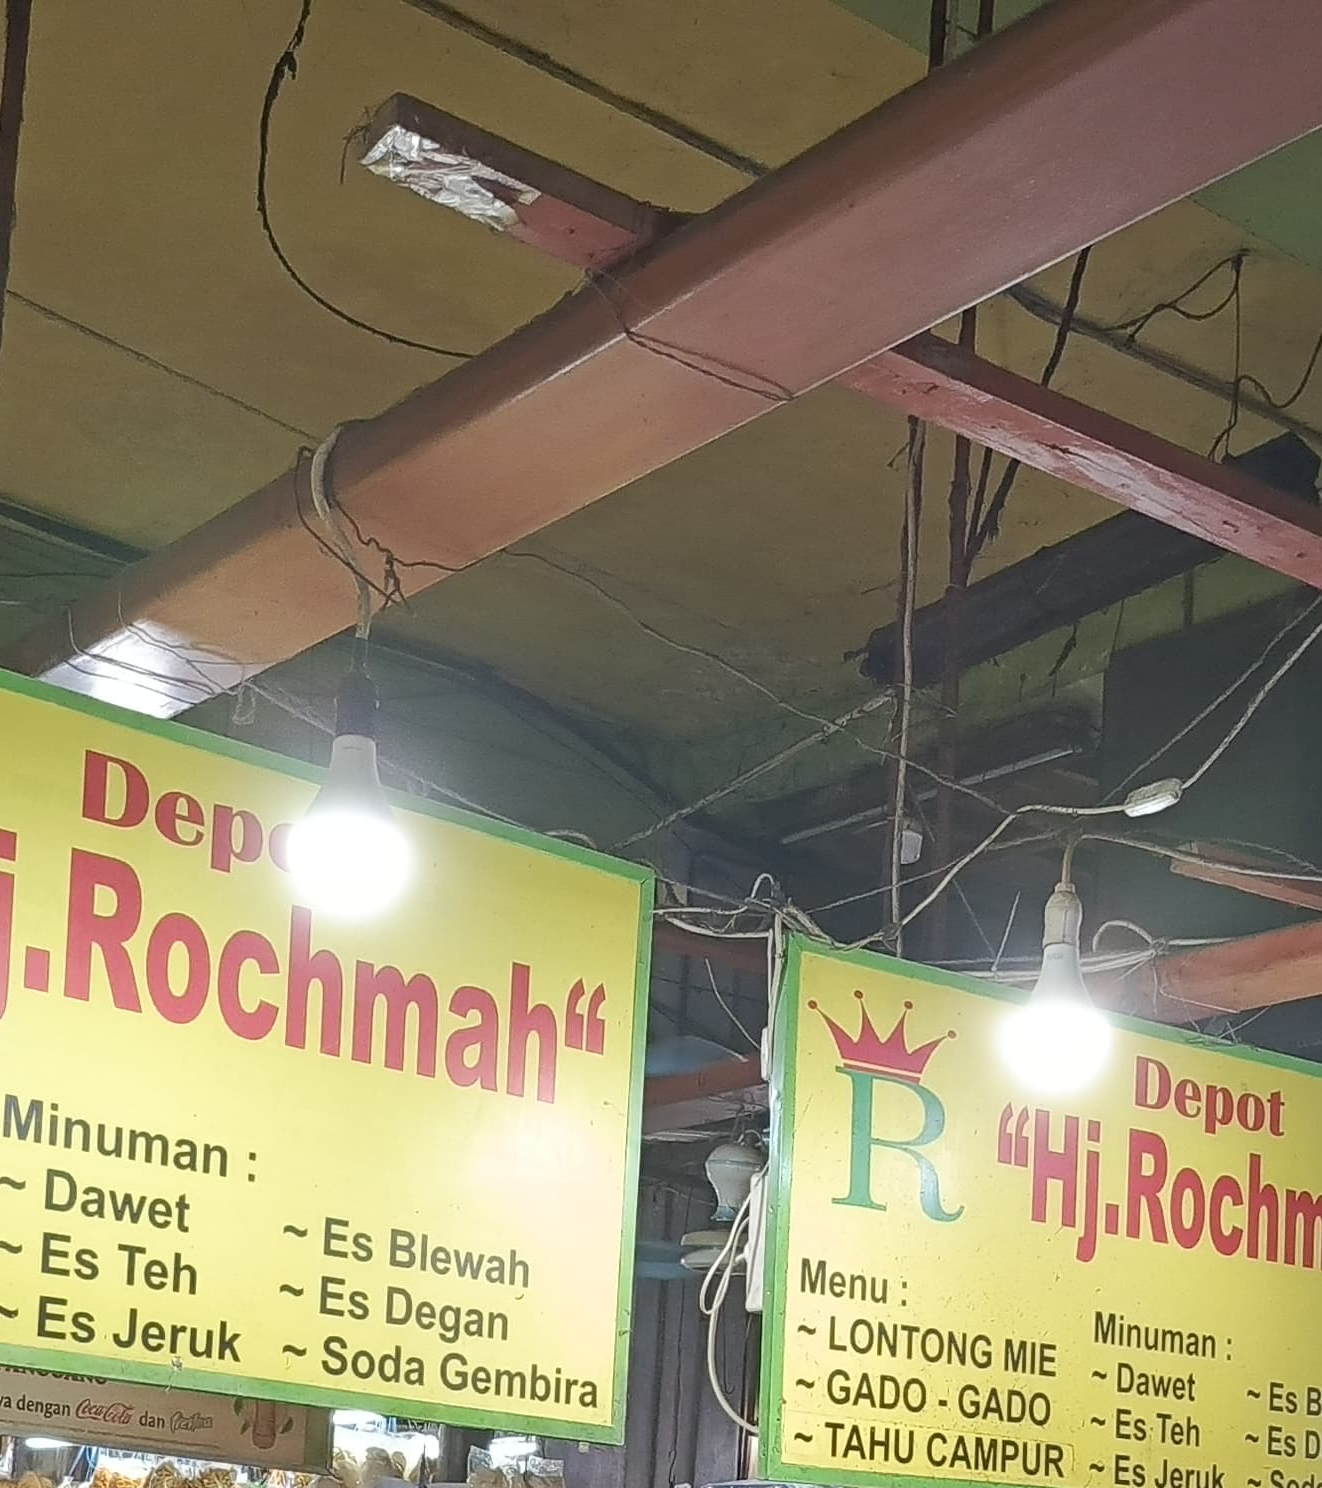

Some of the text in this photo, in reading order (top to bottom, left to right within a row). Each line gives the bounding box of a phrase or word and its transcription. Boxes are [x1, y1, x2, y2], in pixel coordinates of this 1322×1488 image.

[80, 748, 299, 873] Dep
[1133, 1055, 1286, 1138] Depot
[1, 1094, 229, 1177] Minuman
[831, 1065, 965, 1223] R
[43, 1168, 191, 1233] Dawet
[40, 1232, 99, 1280] Es
[117, 1242, 198, 1296] Teh
[322, 1216, 374, 1263] Es
[388, 1227, 530, 1288] Blewah
[800, 1257, 889, 1305] Menu
[36, 1294, 96, 1344] Es
[112, 1307, 242, 1363] Jeruk
[319, 1276, 370, 1322] Es
[385, 1287, 509, 1344] Degan
[1093, 1310, 1217, 1359] Minuman
[321, 1336, 426, 1387] Soda
[439, 1348, 600, 1409] Gembira
[828, 1315, 993, 1370] LONTONG
[1003, 1337, 1058, 1378] MIE
[15, 1394, 72, 1419] dengan
[138, 1410, 166, 1430] dan
[826, 1368, 928, 1413] GADO
[957, 1383, 1052, 1427] GADO
[1116, 1362, 1197, 1402] Dawet
[1268, 1381, 1299, 1415] Es
[824, 1421, 915, 1465] TAHU
[926, 1432, 1066, 1478] CAMPUR
[1115, 1408, 1148, 1442] Es
[1155, 1412, 1201, 1448] Teh
[1266, 1425, 1298, 1458] Es
[1113, 1453, 1147, 1488] Es
